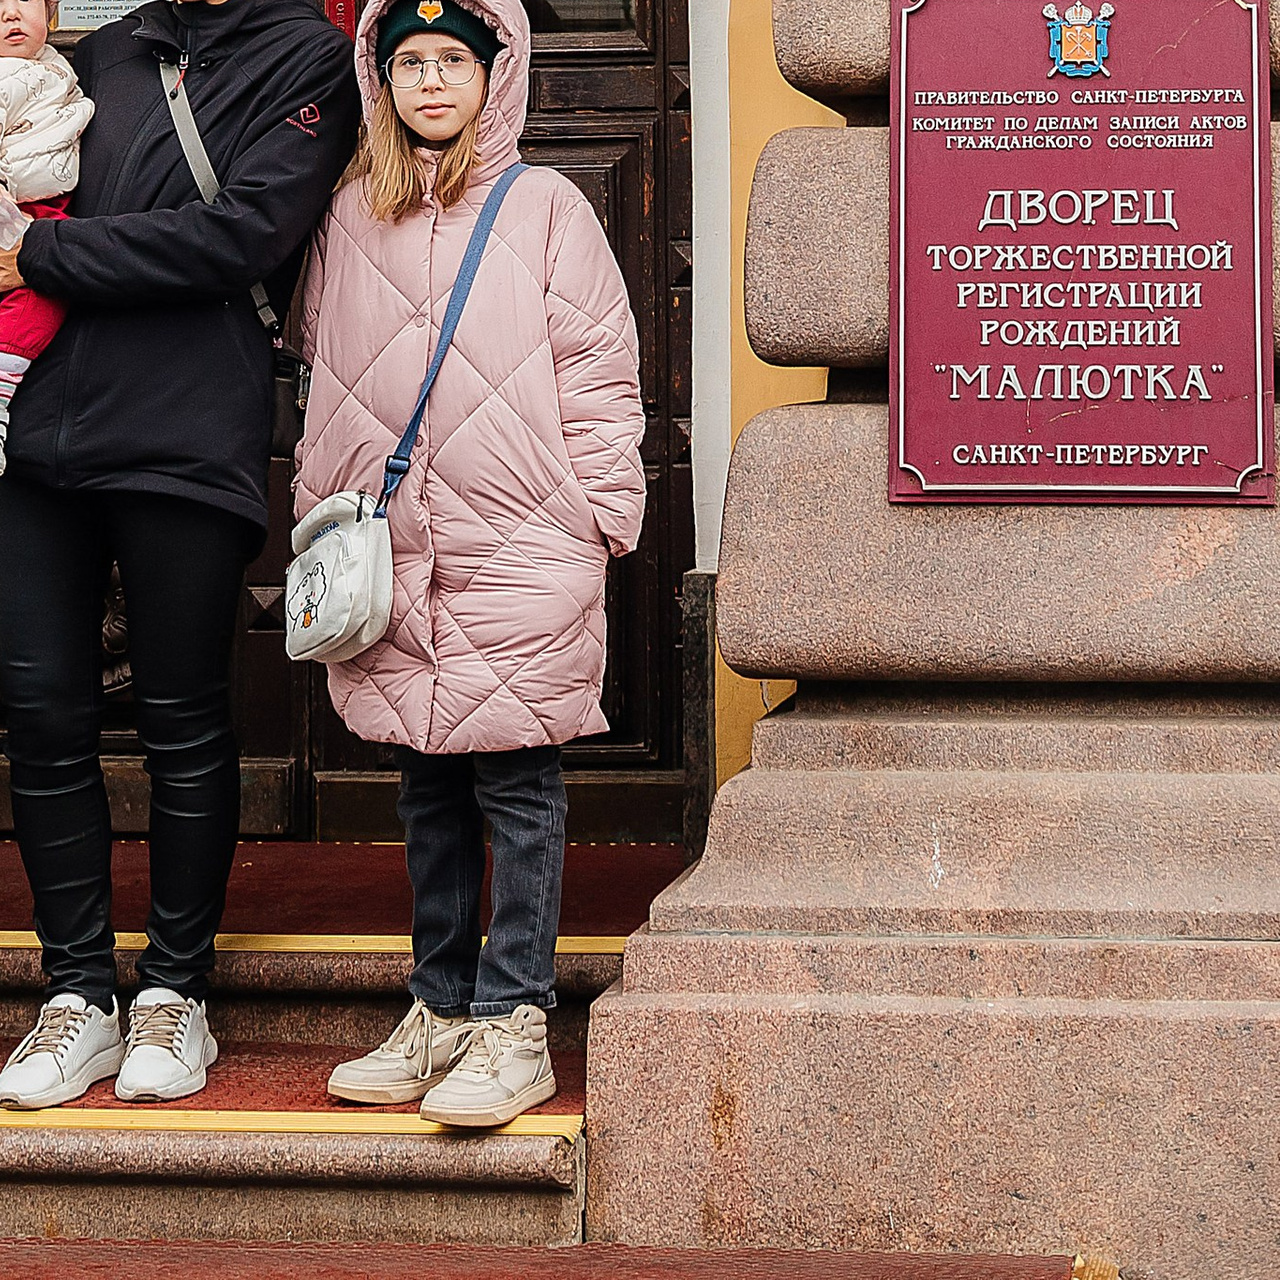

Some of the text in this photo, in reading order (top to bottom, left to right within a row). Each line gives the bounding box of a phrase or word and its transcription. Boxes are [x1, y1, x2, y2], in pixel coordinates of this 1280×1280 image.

[914, 89, 1245, 105] ПРАВИТЕЛЬСТВО САНКТ-ПЕТЕРБУРГА
[912, 115, 1247, 132] КОМИТЕТ ПО ДЕЛАМ ЗАПИСИ АКТОВ
[945, 134, 1214, 151] ГРАЖДАНСКОГО СОСТОЯНИЯ
[977, 189, 1179, 232] ДВОРЕЦ
[926, 239, 1234, 270] ТОРЖЕСТВЕННОЙ
[956, 282, 1203, 313] РЕГИСТРАЦИИ
[979, 315, 1181, 351] РОЖДЕНИЙ
[952, 444, 1209, 465] САНКТ-ПЕТЕРБУРГ
